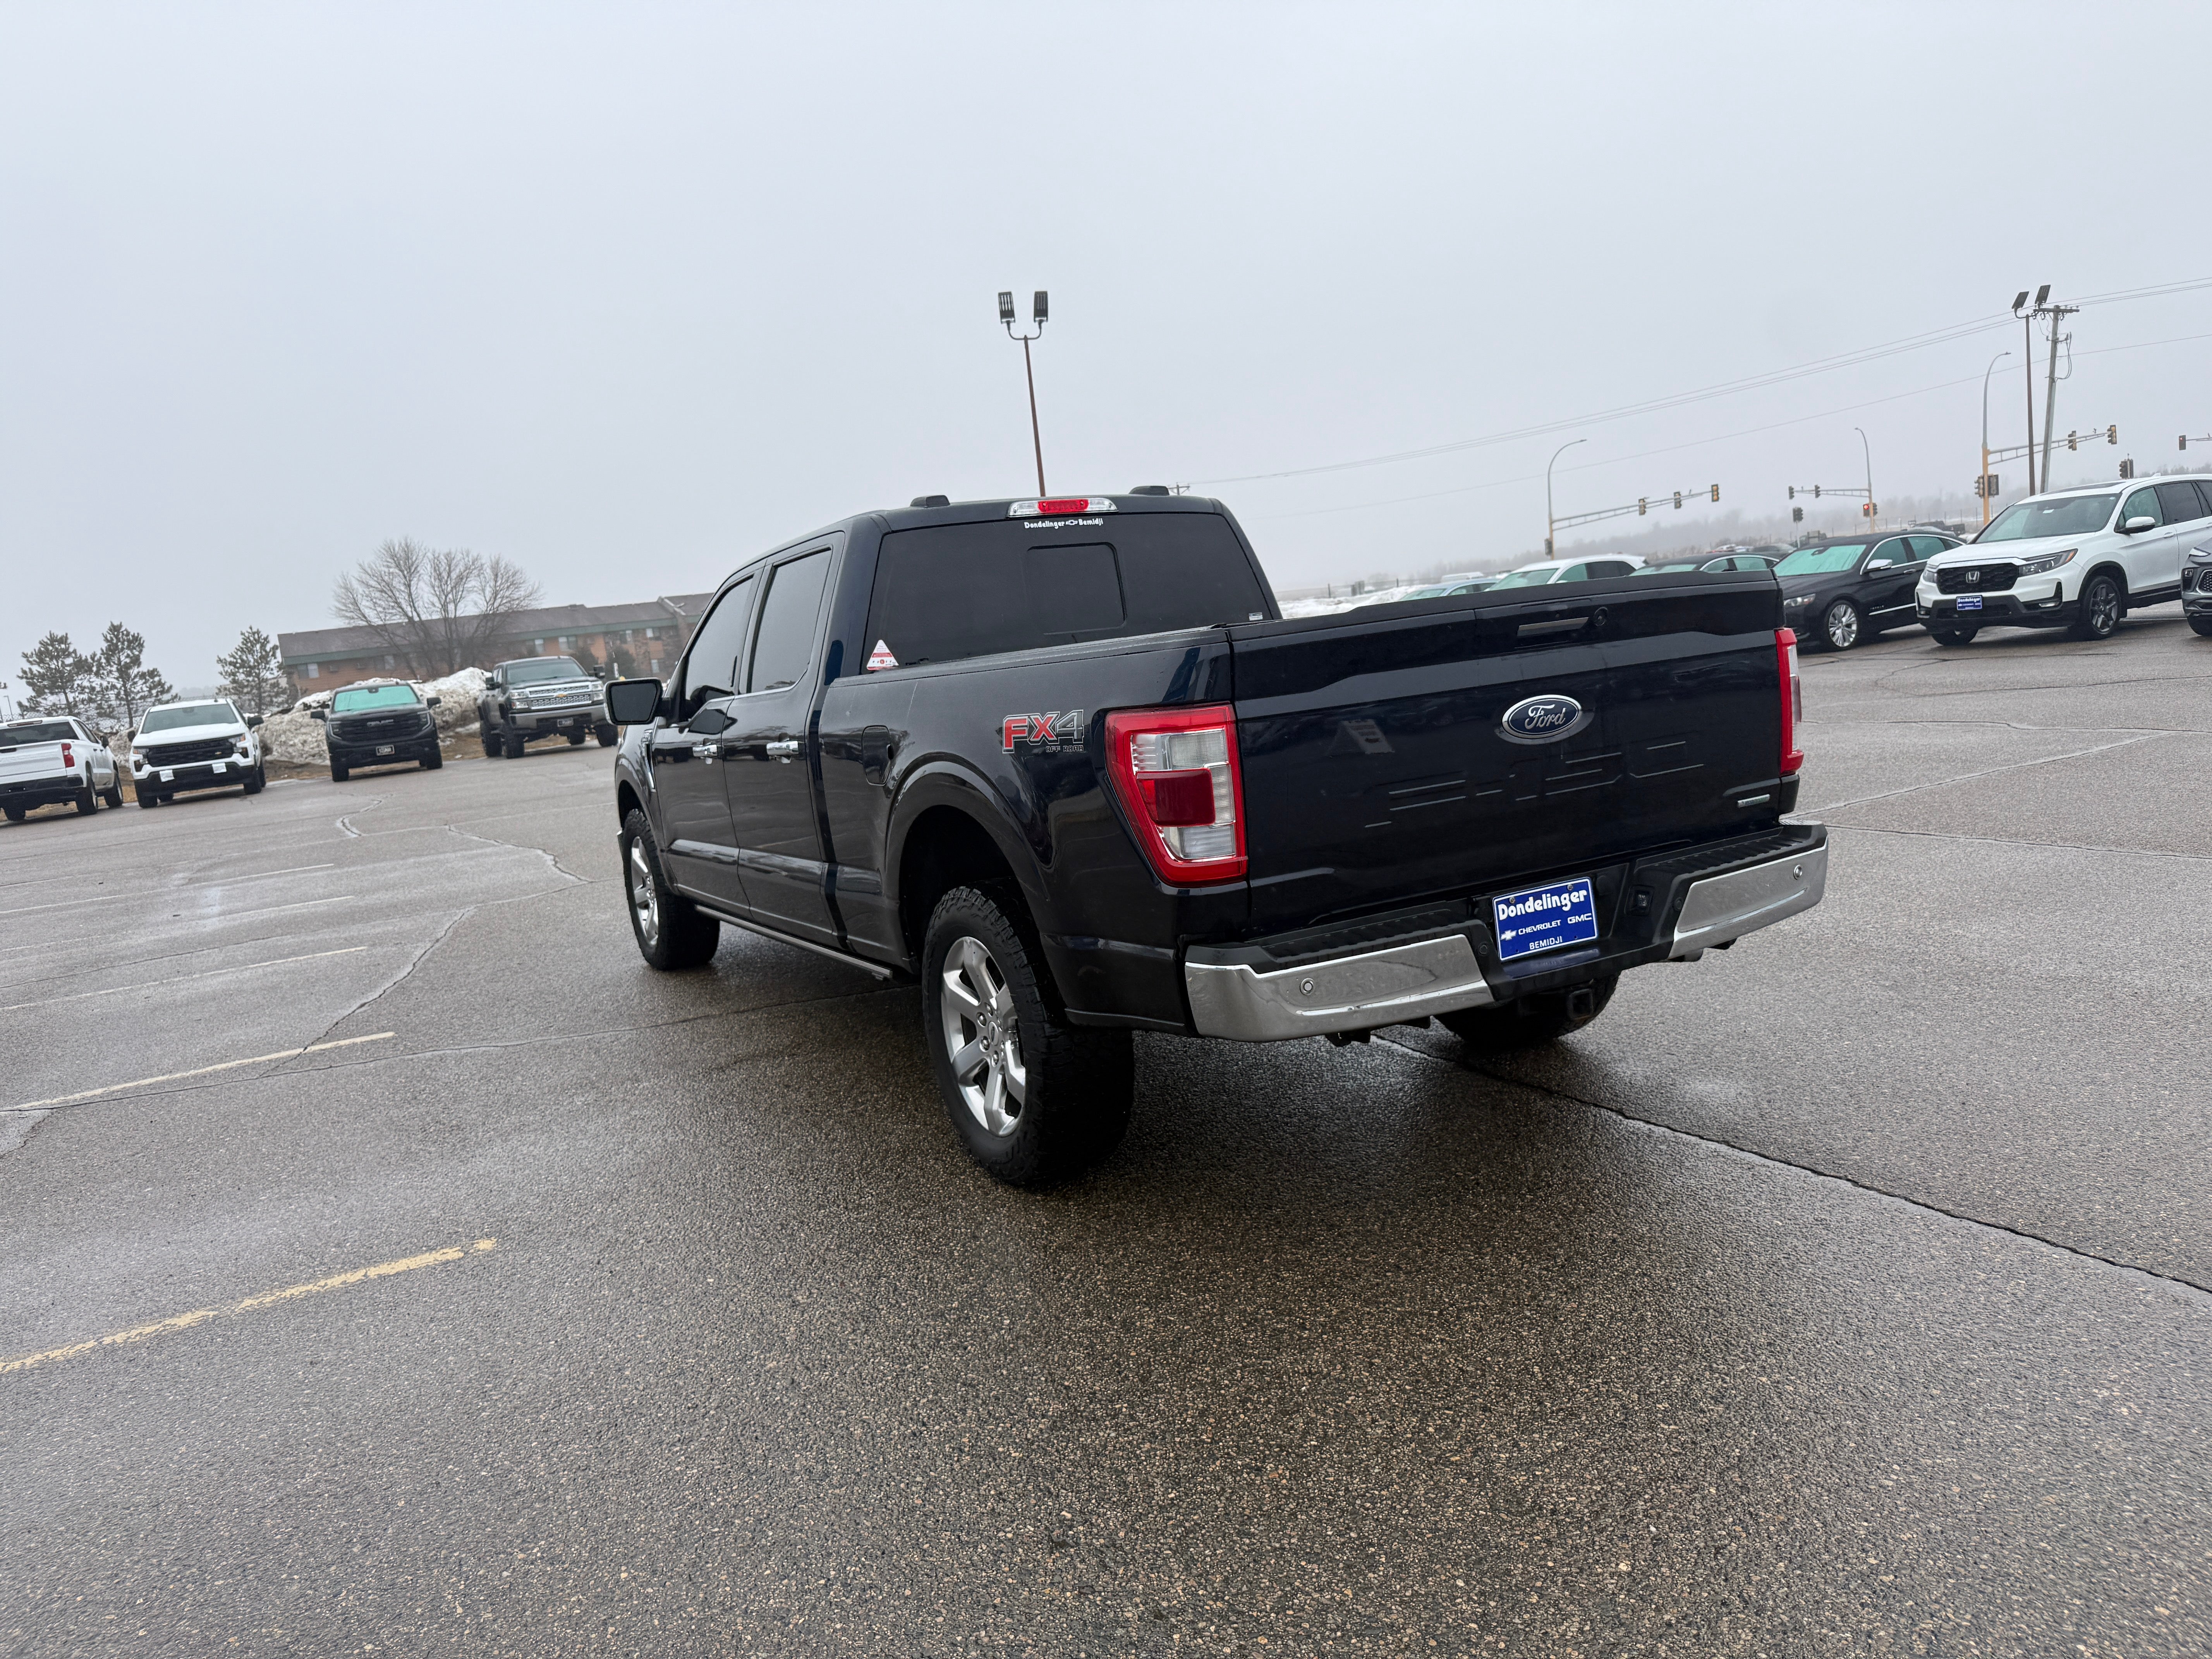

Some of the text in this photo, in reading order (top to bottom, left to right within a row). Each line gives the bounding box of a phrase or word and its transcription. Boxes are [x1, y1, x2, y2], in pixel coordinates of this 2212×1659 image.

[1024, 520, 1065, 529] Dondelinger
[1525, 704, 1567, 730] Ford
[1003, 709, 1084, 754] FX4
[1498, 890, 1587, 921] Dondelinger
[1518, 913, 1592, 935] CHEVROLET GMC
[1529, 936, 1563, 950] BEMIDJI
